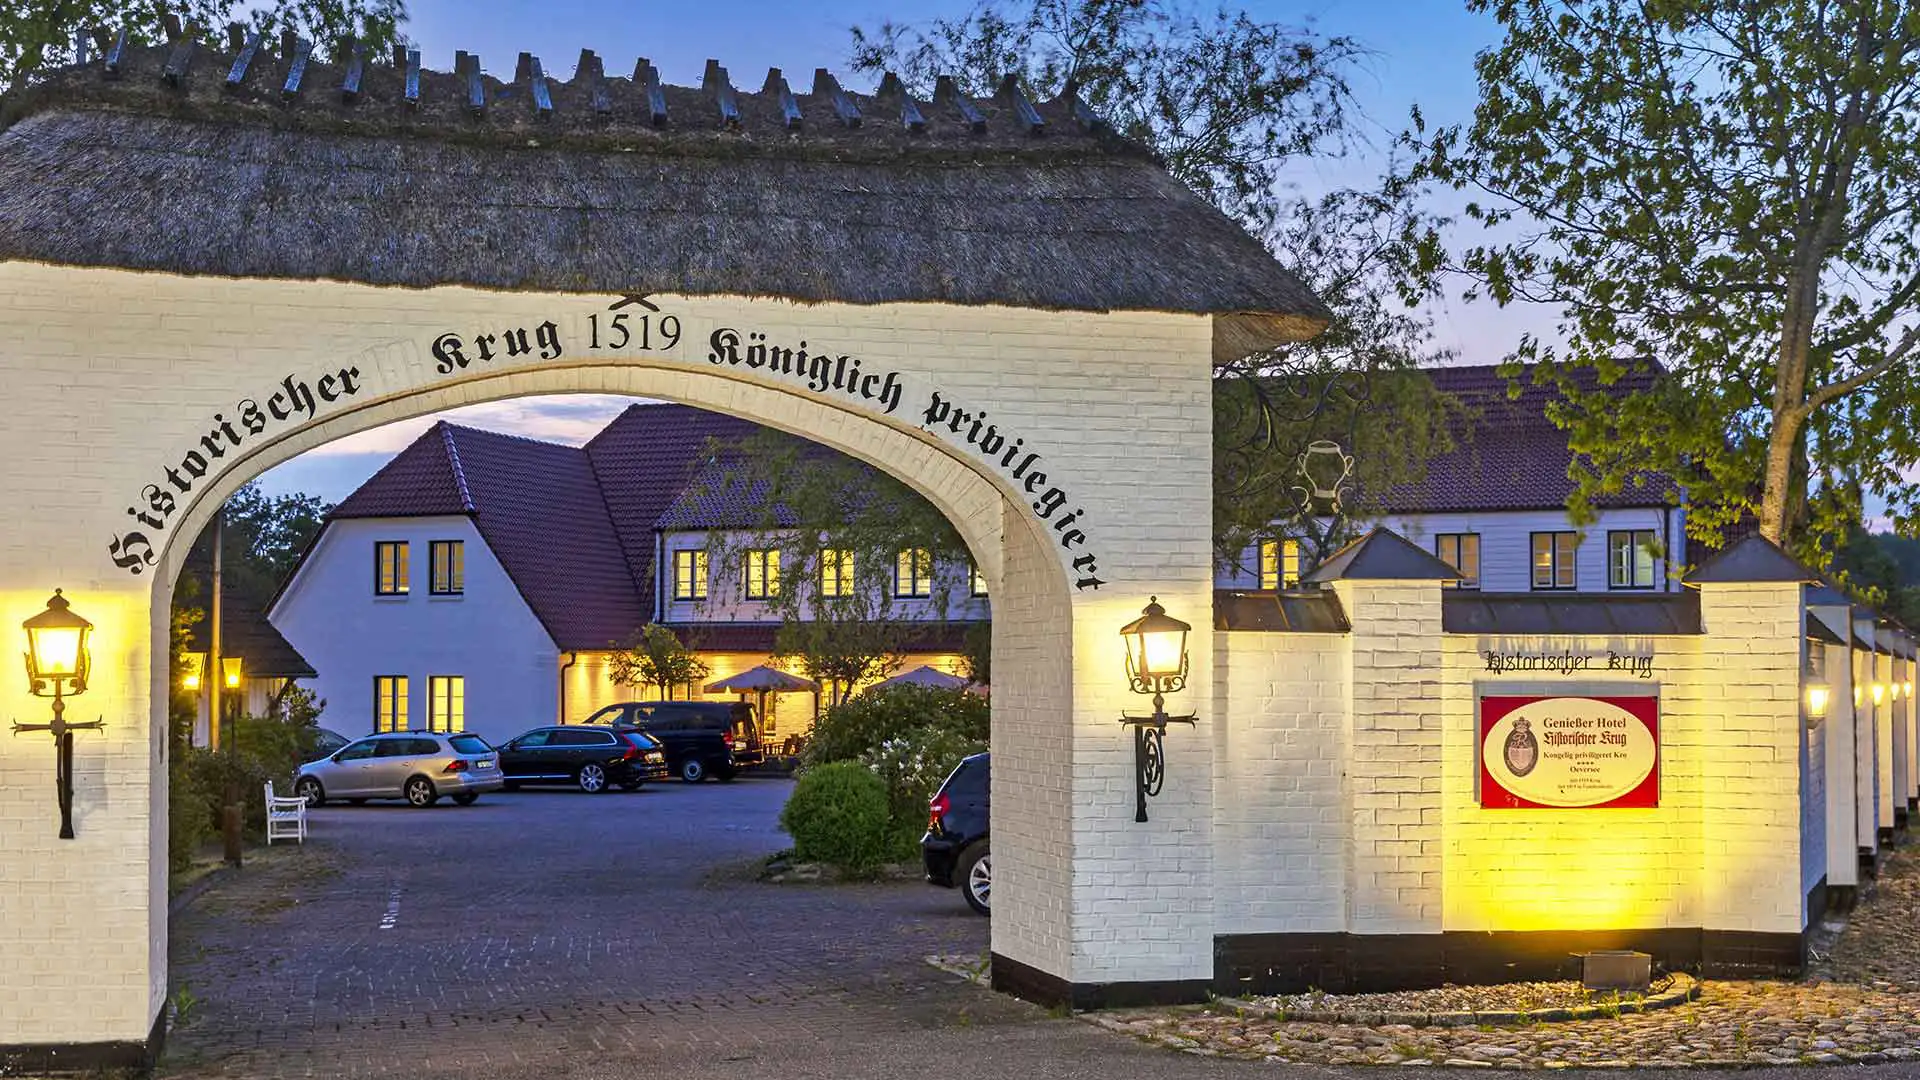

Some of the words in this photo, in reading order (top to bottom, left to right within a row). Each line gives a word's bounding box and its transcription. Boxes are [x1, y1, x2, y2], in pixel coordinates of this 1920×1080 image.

[588, 314, 681, 350] 1519
[109, 363, 361, 575] Historischer
[432, 319, 562, 374] Krug
[709, 328, 903, 414] Königlich
[923, 391, 1107, 592] privilegiert
[1485, 650, 1592, 675] Historischer
[1607, 650, 1653, 678] Krug
[1543, 717, 1594, 728] Genießer
[1597, 717, 1626, 728] Hotel
[1599, 730, 1627, 747] Krug
